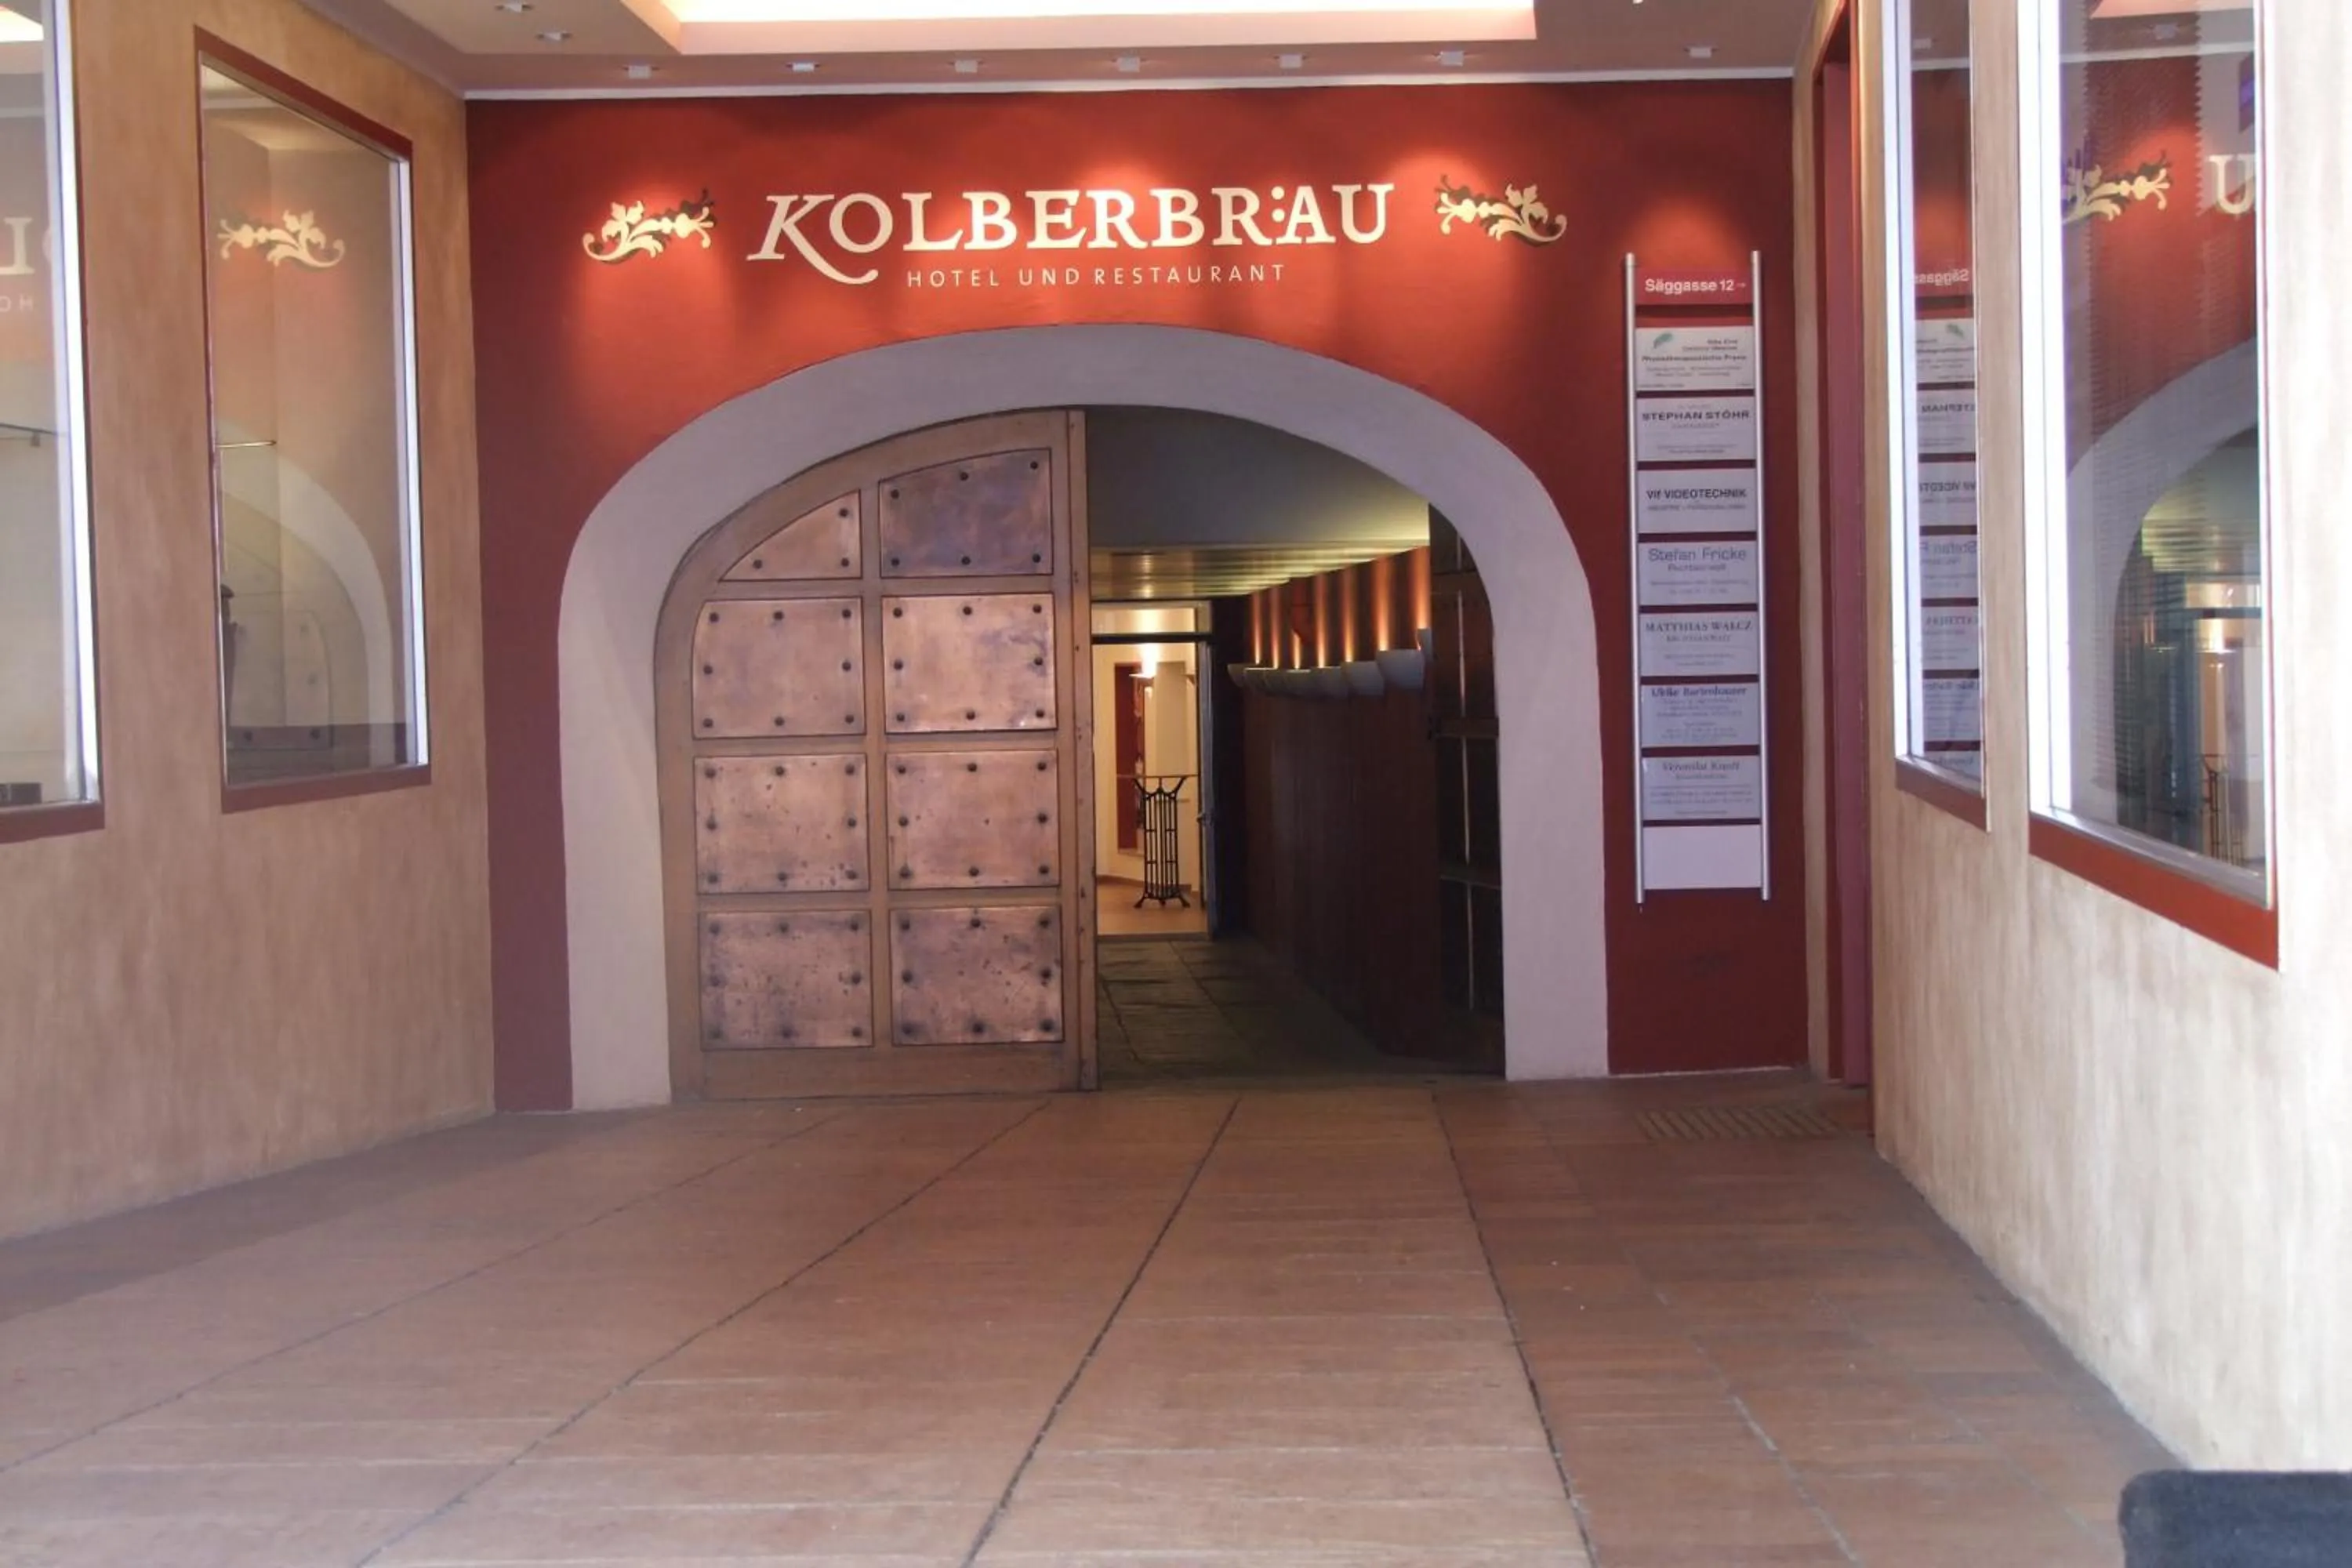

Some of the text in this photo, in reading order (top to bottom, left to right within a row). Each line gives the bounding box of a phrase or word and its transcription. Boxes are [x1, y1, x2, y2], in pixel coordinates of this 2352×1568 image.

[907, 263, 1285, 287] HOTEL UND RESTAURANT
[1645, 278, 1735, 295] Säggasse 12
[1642, 407, 1750, 422] STEPHAN STÖHR
[1664, 488, 1748, 499] VIDEOTECHNIK
[1648, 546, 1747, 562] Stefan Fricke
